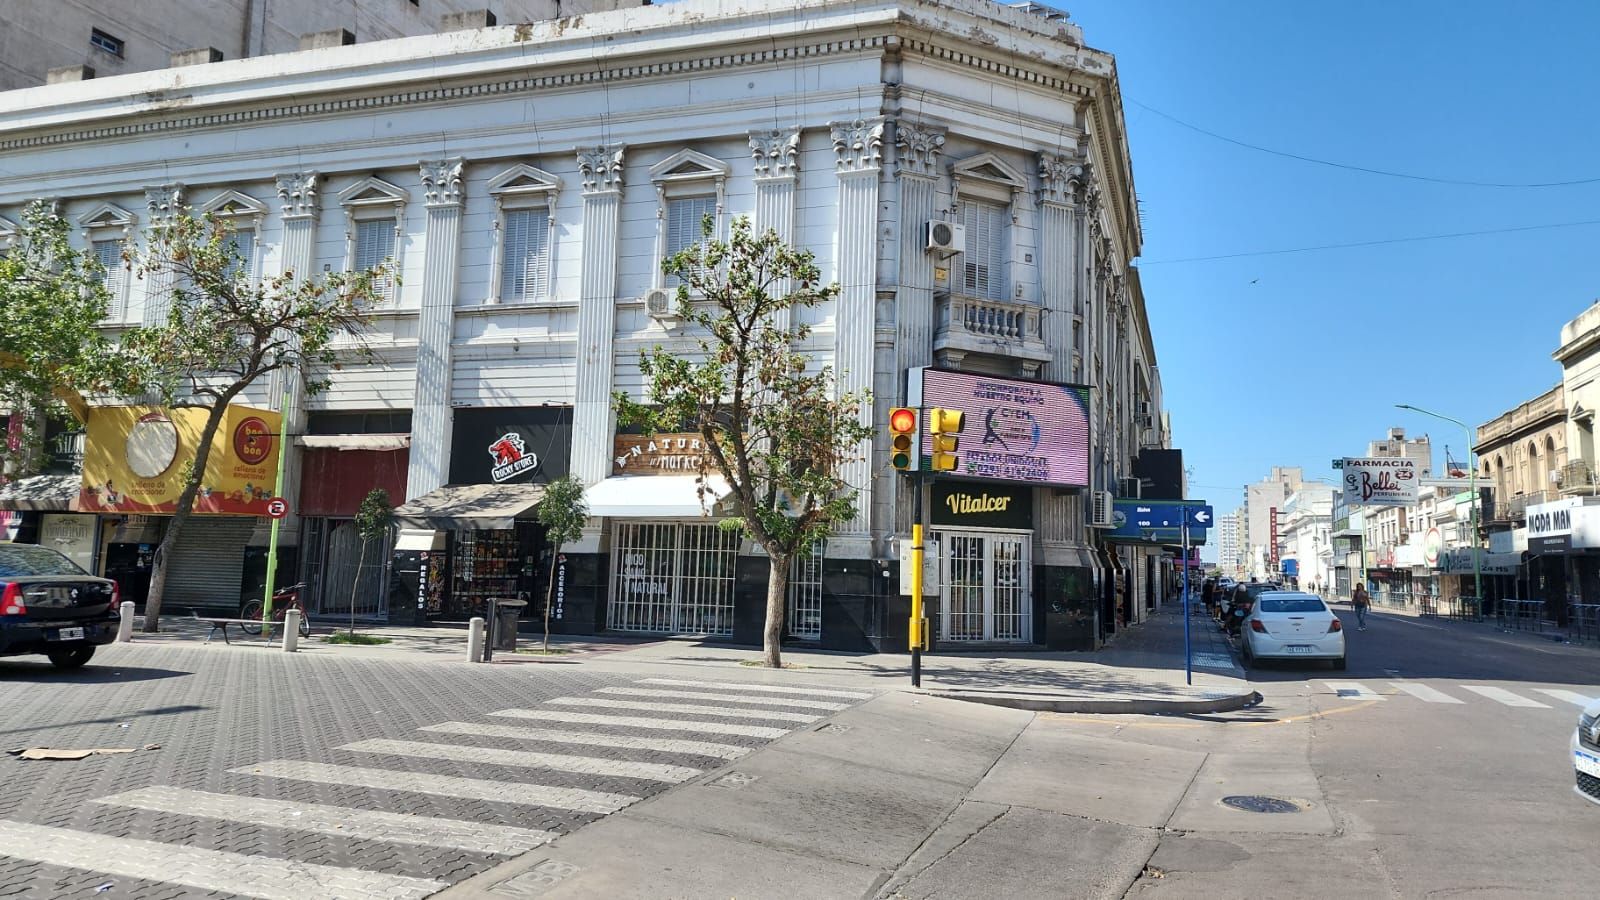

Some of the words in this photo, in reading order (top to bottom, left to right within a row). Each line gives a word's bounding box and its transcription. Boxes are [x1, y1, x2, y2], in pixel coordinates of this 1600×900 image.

[243, 444, 262, 456] bon
[1360, 470, 1402, 502] Bellei
[946, 492, 1011, 515] Vitalcer
[1529, 513, 1551, 533] MODA
[418, 565, 427, 609] REGALOS
[556, 565, 565, 619] ACCESORIOS
